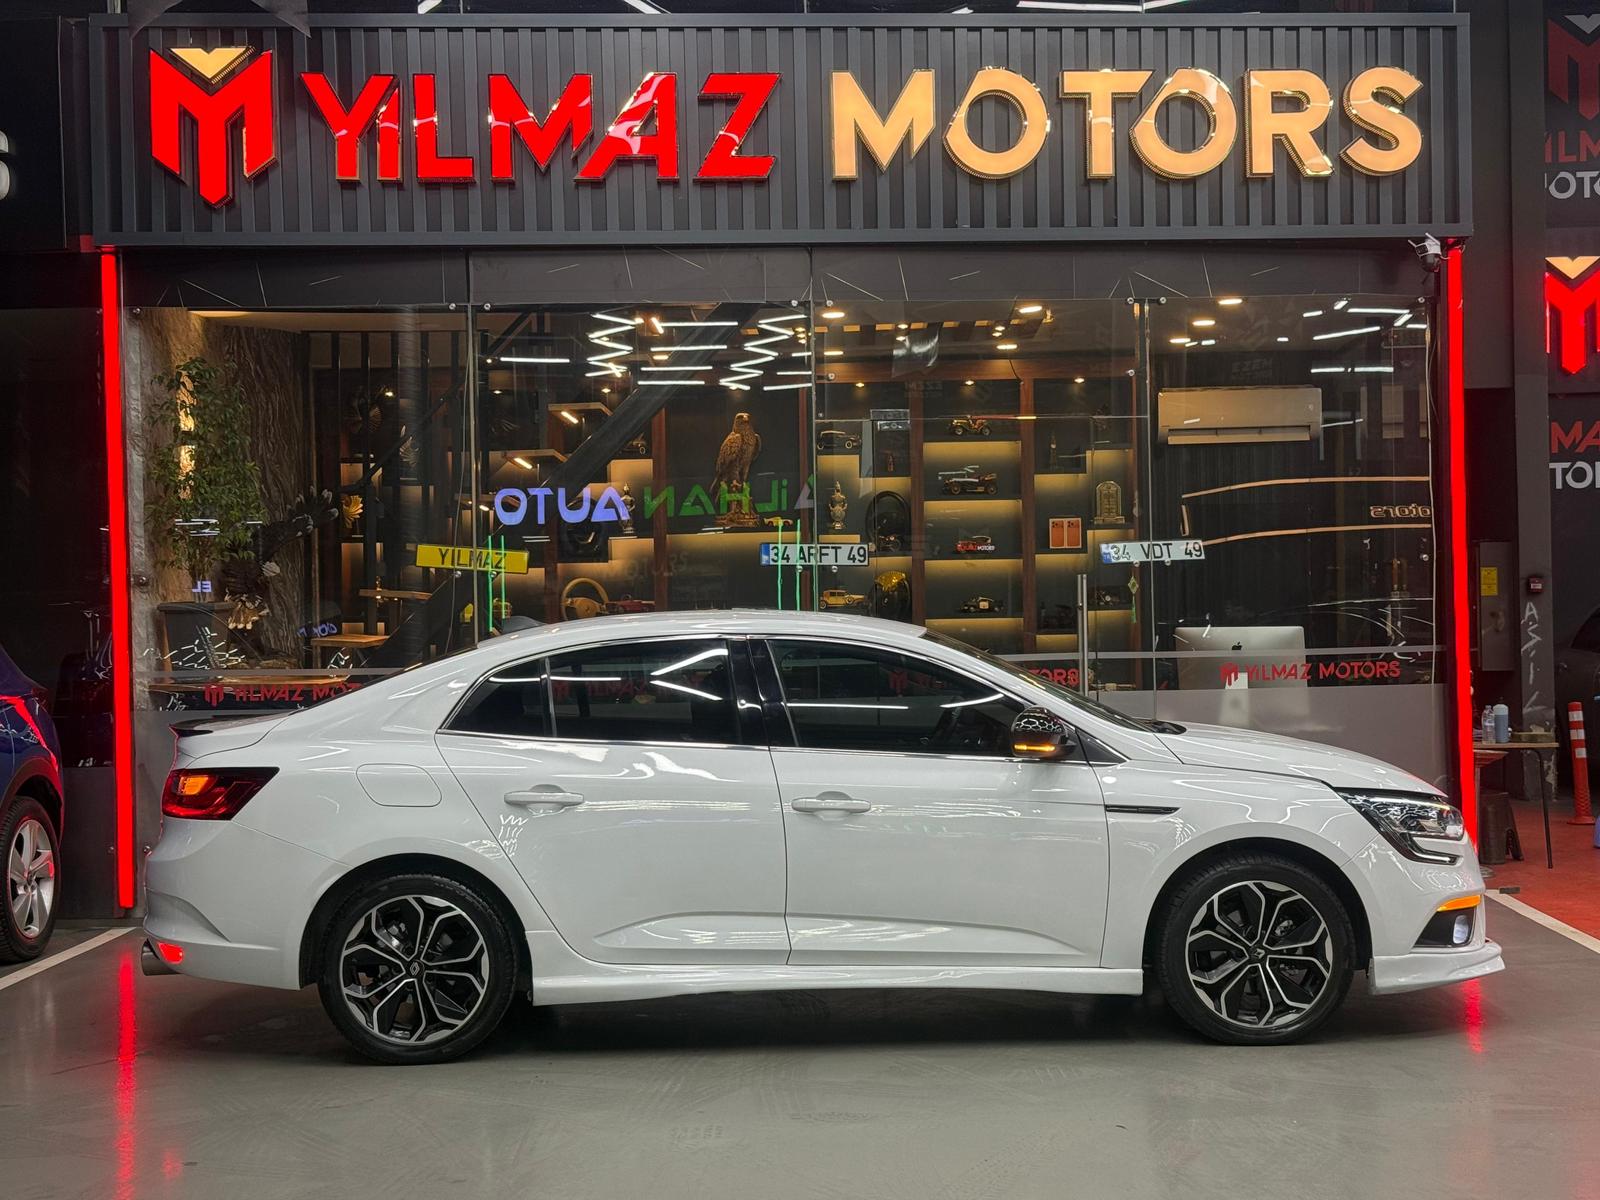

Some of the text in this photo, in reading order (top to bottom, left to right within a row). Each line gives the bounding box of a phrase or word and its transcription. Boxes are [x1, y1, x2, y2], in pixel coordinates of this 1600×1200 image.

[299, 66, 1424, 184] YILMAZ MOTORS
[1544, 130, 1600, 163] ILM
[1544, 171, 1600, 200] OT
[438, 547, 506, 570] YILMAZ
[770, 546, 790, 563] 34
[847, 546, 867, 563] 49
[1111, 544, 1131, 560] 34
[1140, 543, 1172, 559] VDT
[1184, 542, 1202, 558] 49
[1245, 660, 1401, 682] YILMAZ MOTORS
